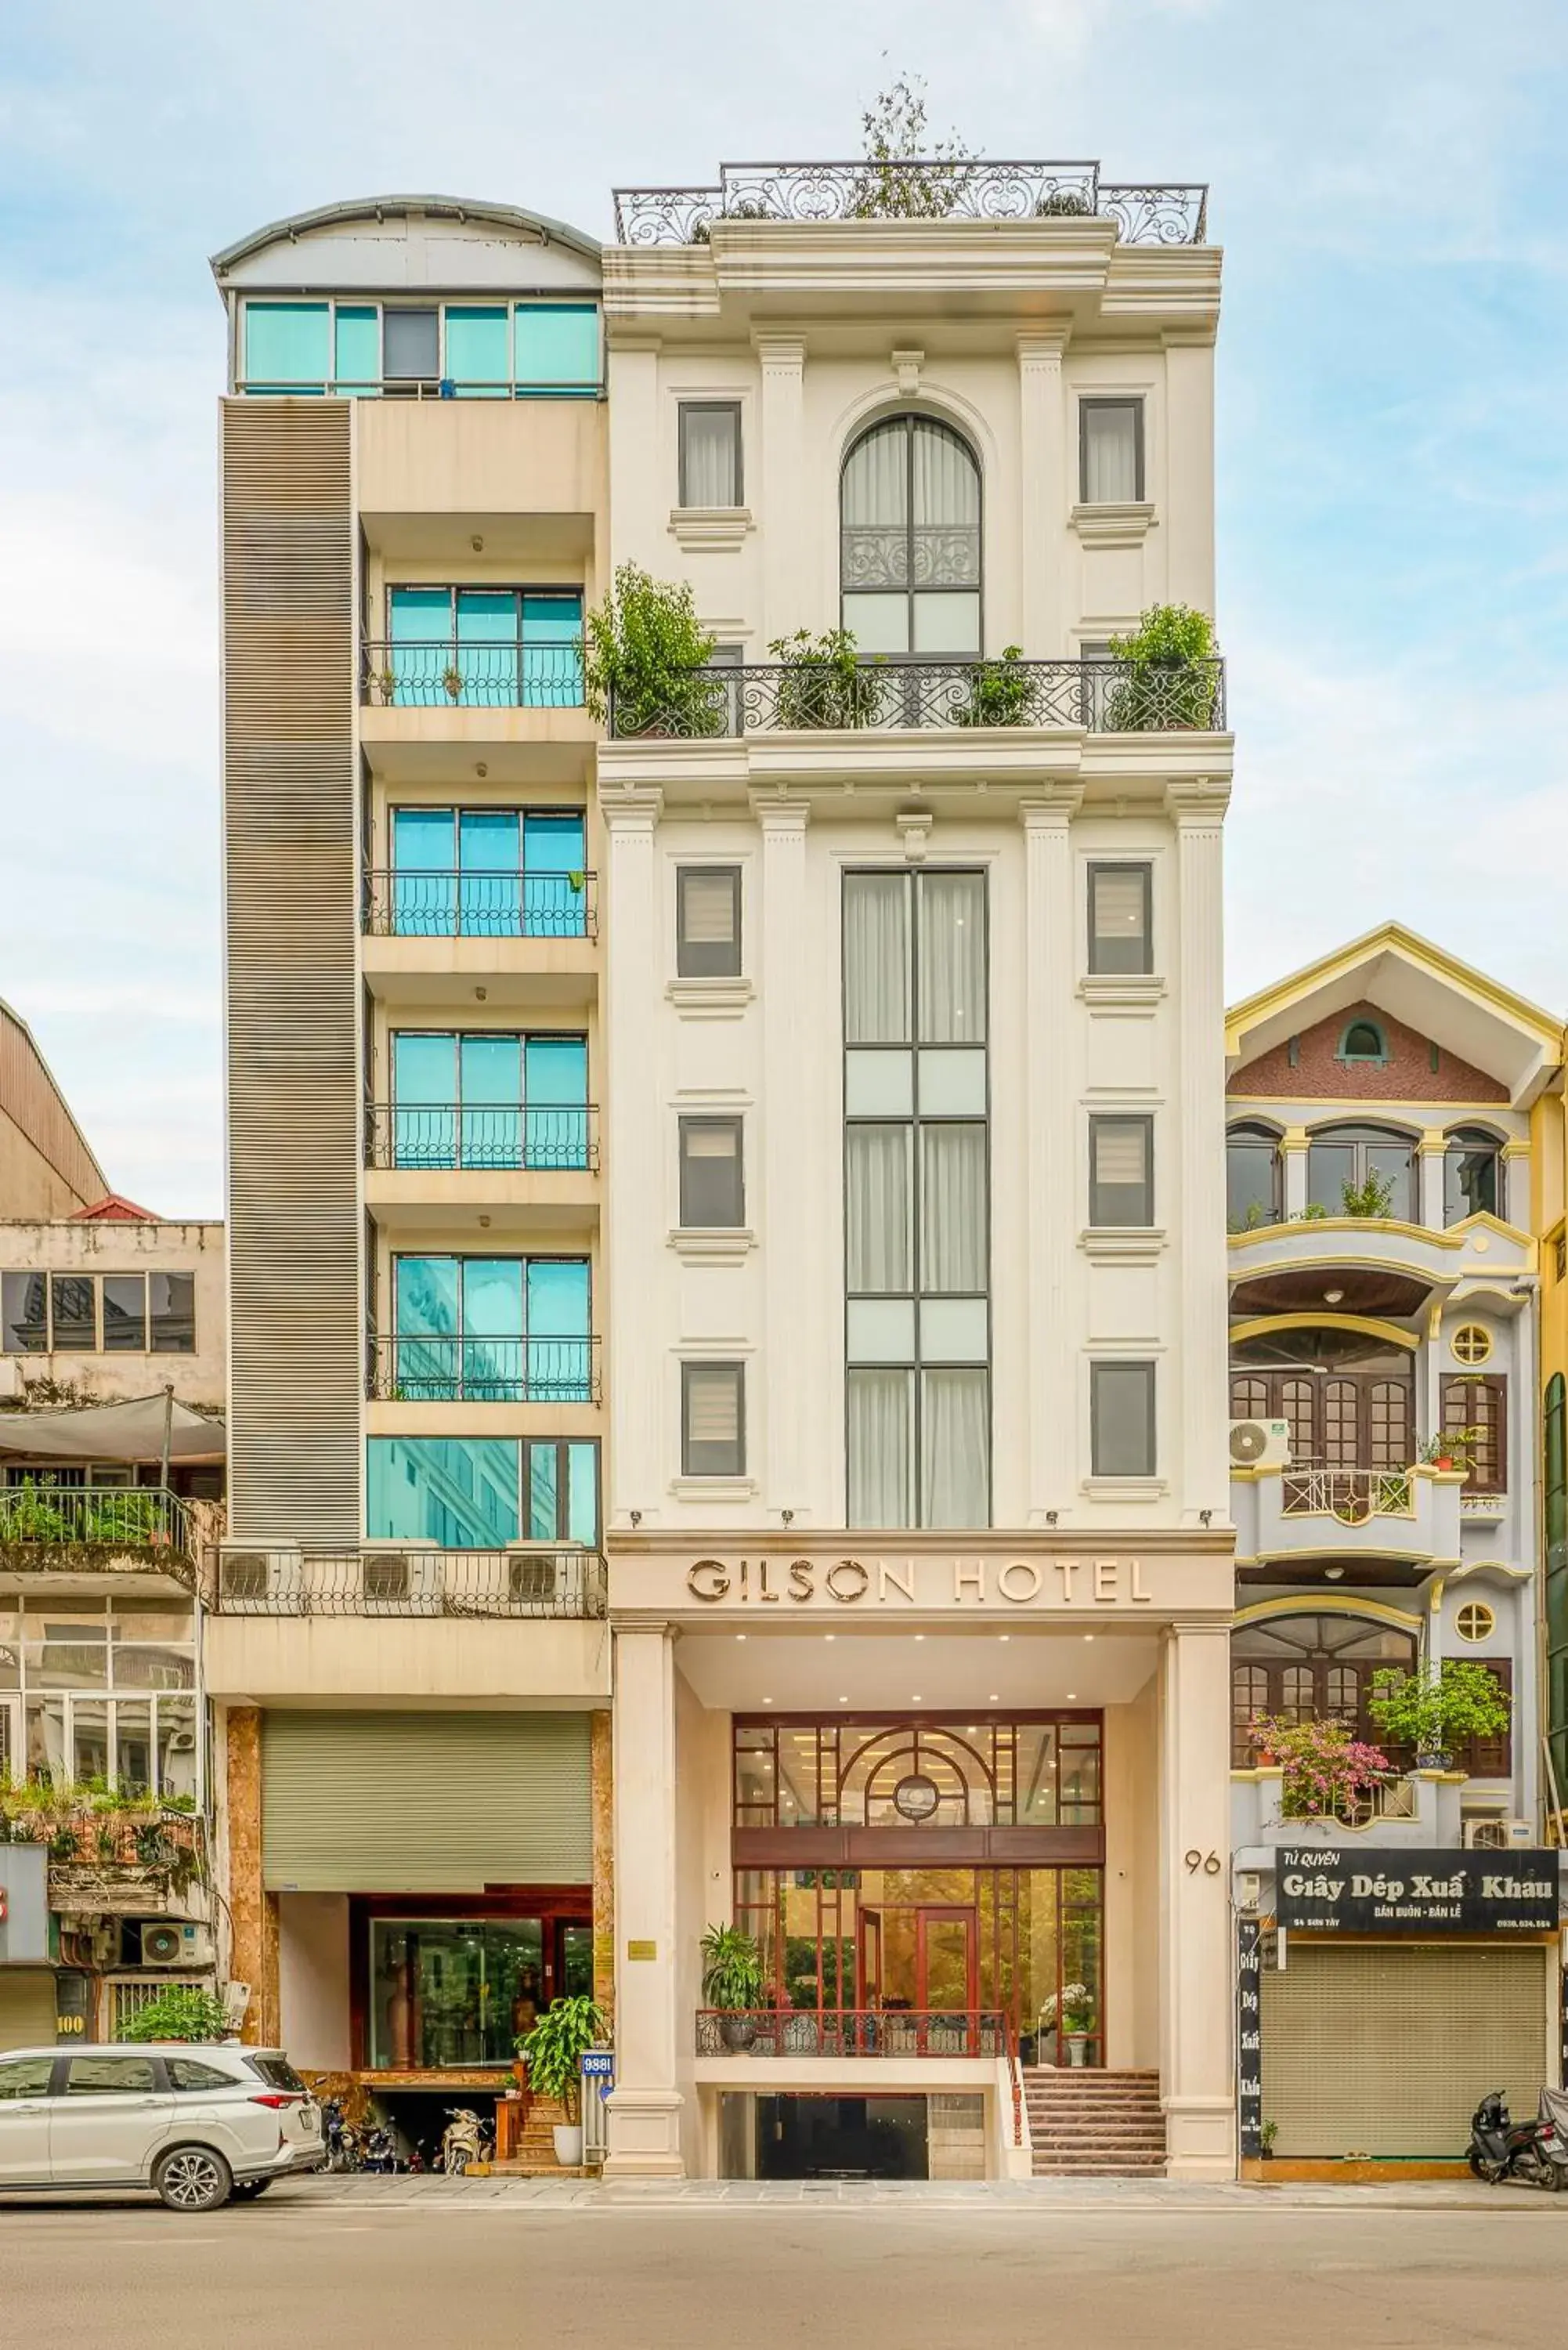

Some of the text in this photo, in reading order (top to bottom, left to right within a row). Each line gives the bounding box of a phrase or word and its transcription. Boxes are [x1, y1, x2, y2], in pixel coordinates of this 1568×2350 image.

[688, 1560, 1152, 1603] GILSON HOTEL
[1185, 1849, 1221, 1875] 96
[1350, 1874, 1404, 1902] Dép
[57, 2016, 85, 2034] 100
